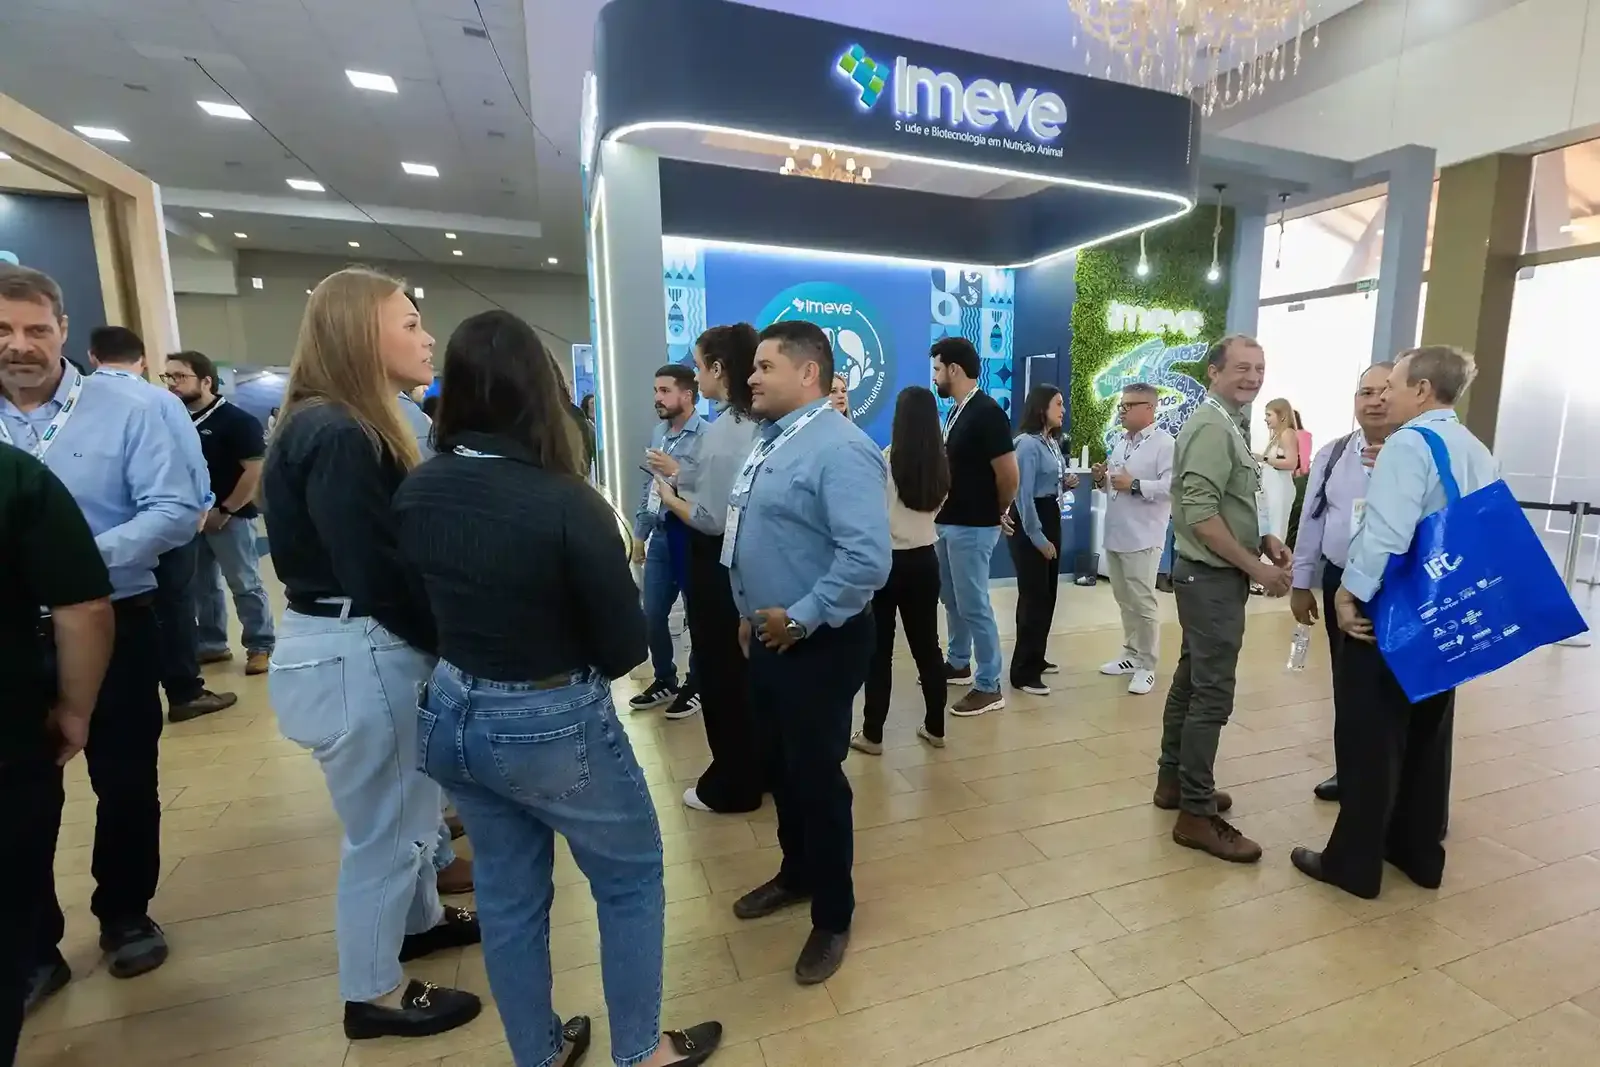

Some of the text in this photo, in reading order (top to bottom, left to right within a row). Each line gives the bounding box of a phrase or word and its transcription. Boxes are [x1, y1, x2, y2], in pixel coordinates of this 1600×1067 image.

[895, 55, 1068, 139] Imeve
[924, 126, 930, 136] e
[931, 127, 986, 147] Biotecnologia
[988, 137, 1001, 148] em
[1002, 138, 1036, 154] Nutrição
[1037, 144, 1064, 158] Animal
[806, 299, 853, 315] Imeve
[852, 371, 885, 419] Aquicultura
[1423, 553, 1457, 580] IFC
